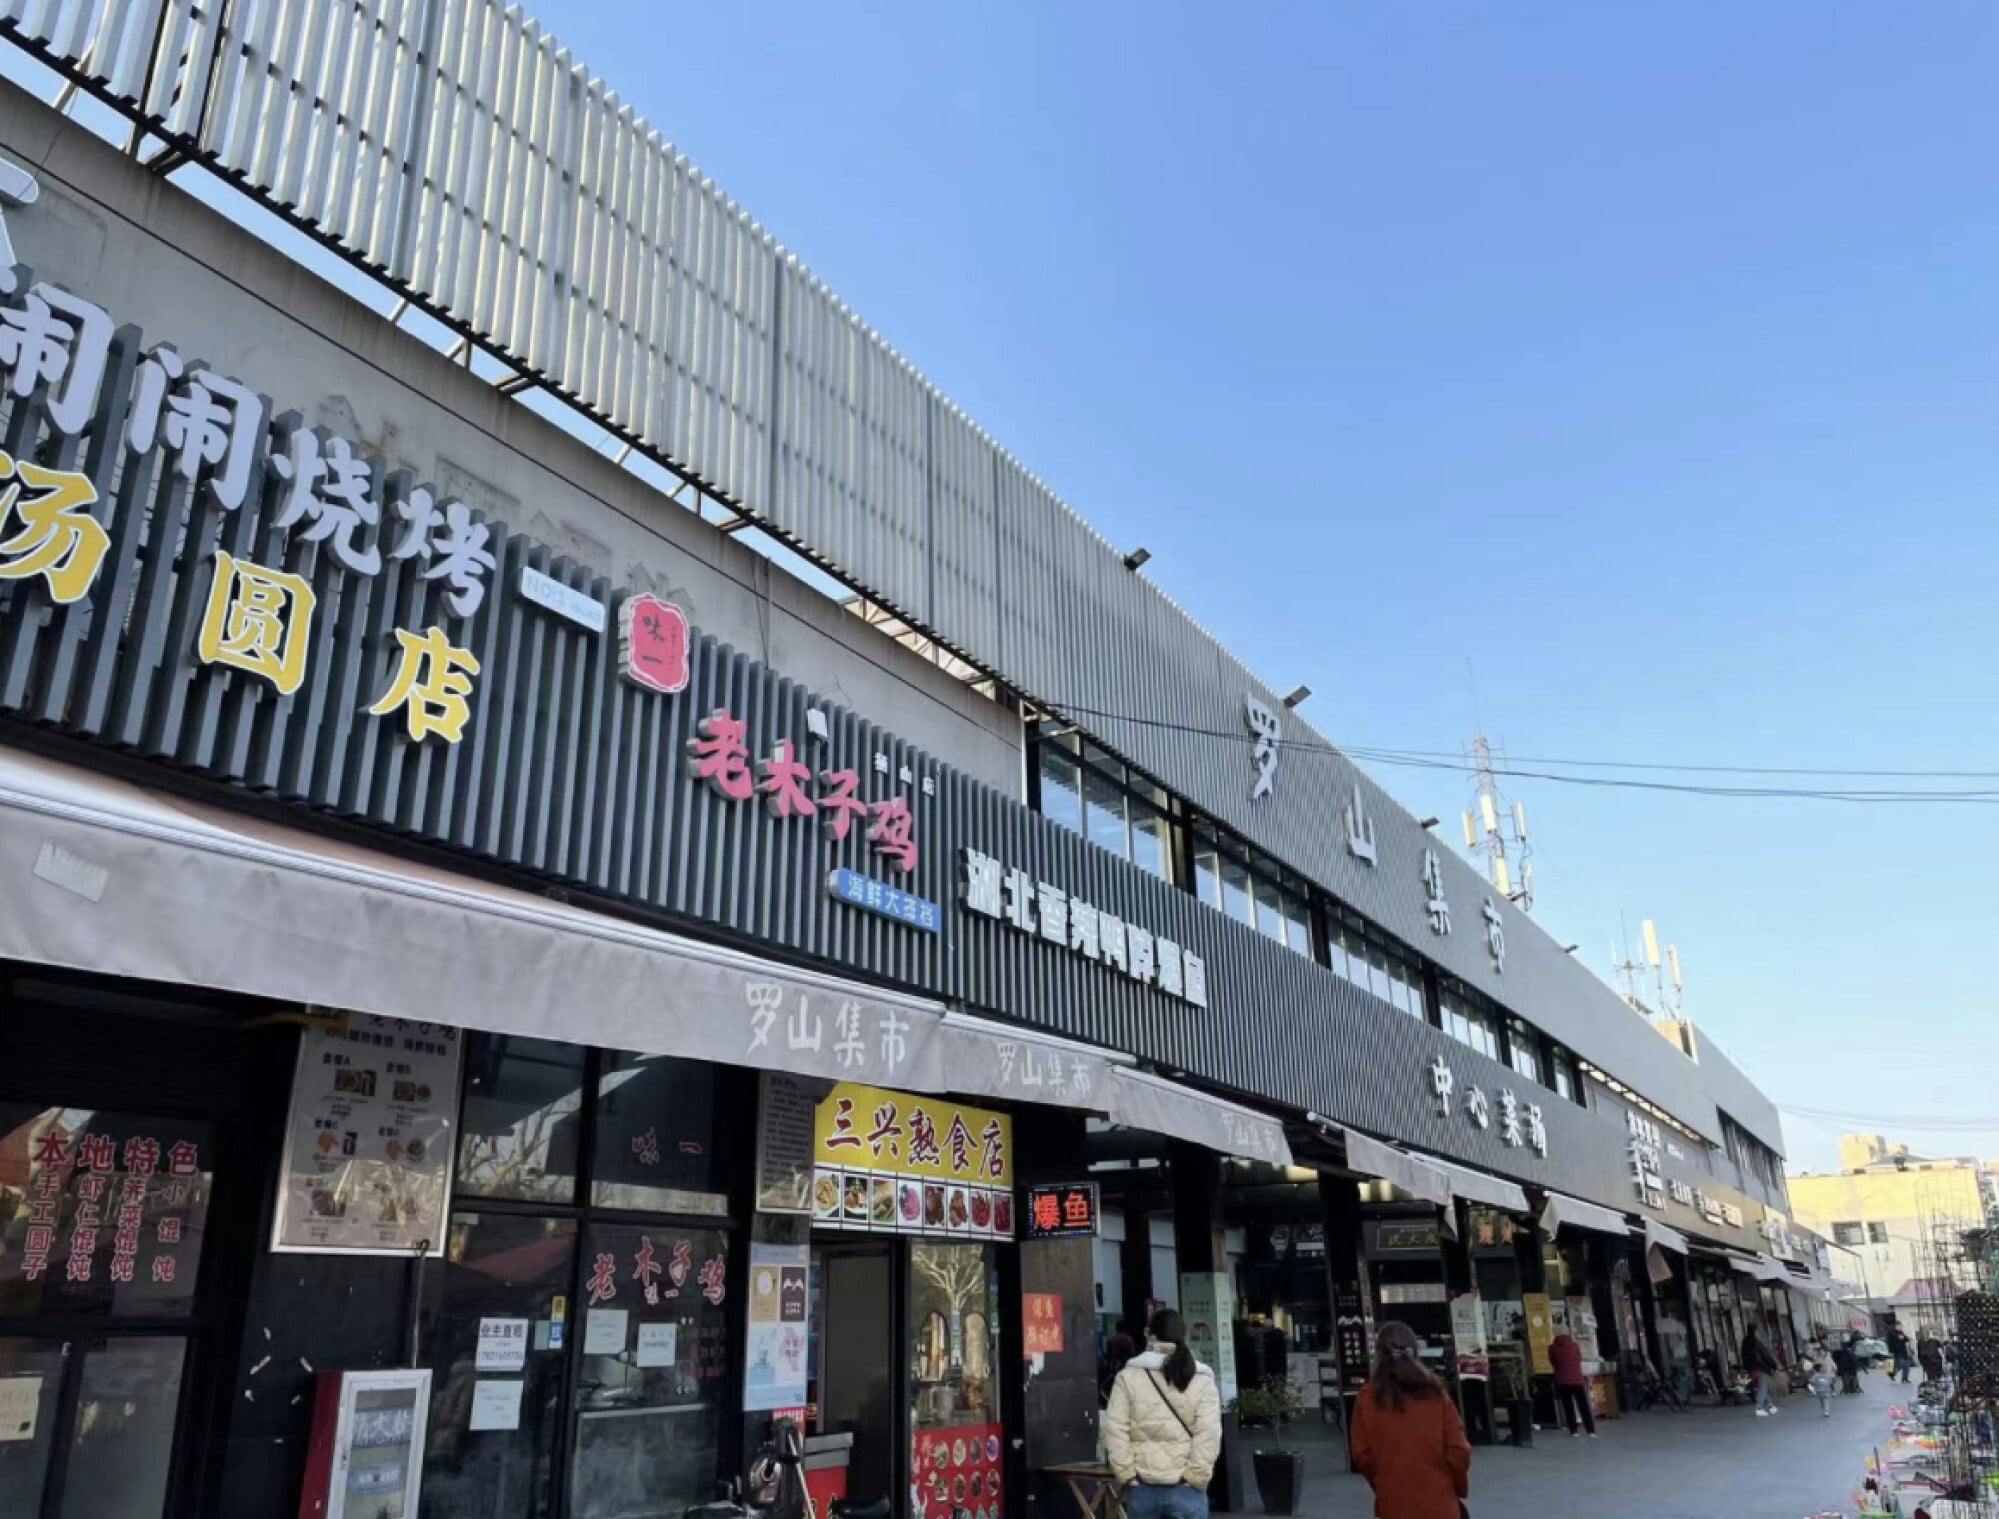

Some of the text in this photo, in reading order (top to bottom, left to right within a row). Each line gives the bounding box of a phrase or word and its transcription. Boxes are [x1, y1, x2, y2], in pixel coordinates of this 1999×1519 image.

[688, 708, 919, 872] 老木子鸡
[1247, 691, 1506, 975] 罗山集市
[745, 981, 911, 1075] 罗山集市
[997, 1042, 1093, 1098] 罗山集市
[33, 1132, 200, 1178] 本地特色
[825, 1098, 1010, 1180] 三兴熟食店
[21, 1170, 60, 1281] 手工圆子
[66, 1175, 105, 1282] 虾仁馄饨
[152, 1180, 185, 1282] 小馄饨
[1033, 1191, 1091, 1231] 爆鱼
[586, 1236, 726, 1306] 老木子鸡
